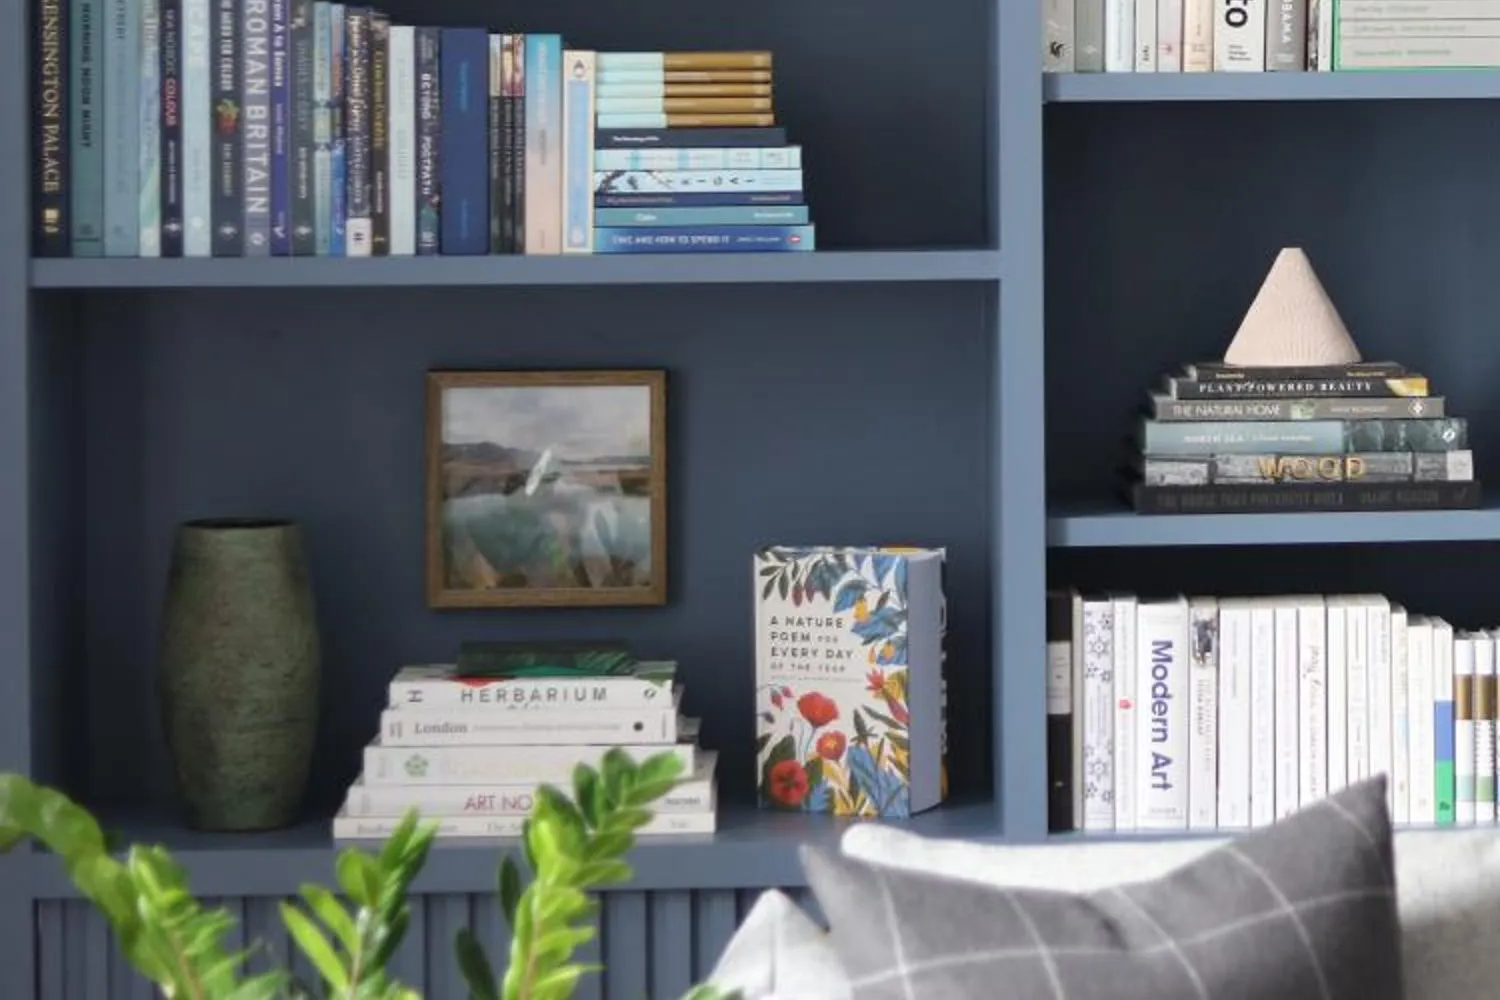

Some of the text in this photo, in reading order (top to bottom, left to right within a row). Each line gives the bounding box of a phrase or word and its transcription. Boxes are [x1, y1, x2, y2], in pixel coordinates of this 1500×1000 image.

[273, 23, 285, 32] A
[273, 35, 285, 47] to
[165, 77, 177, 126] COLOUR
[246, 0, 267, 213] ROMAN BRITAIN
[42, 123, 60, 192] PALACE
[1320, 380, 1372, 392] BEAUTY
[1258, 456, 1366, 480] WOOD
[770, 615, 844, 628] A NATURE
[771, 631, 811, 642] POEM
[771, 647, 854, 659] EVERY DAY
[460, 687, 608, 704] HERBARIUM
[1151, 639, 1174, 791] Modern Art
[414, 721, 468, 735] London
[463, 795, 494, 811] ART
